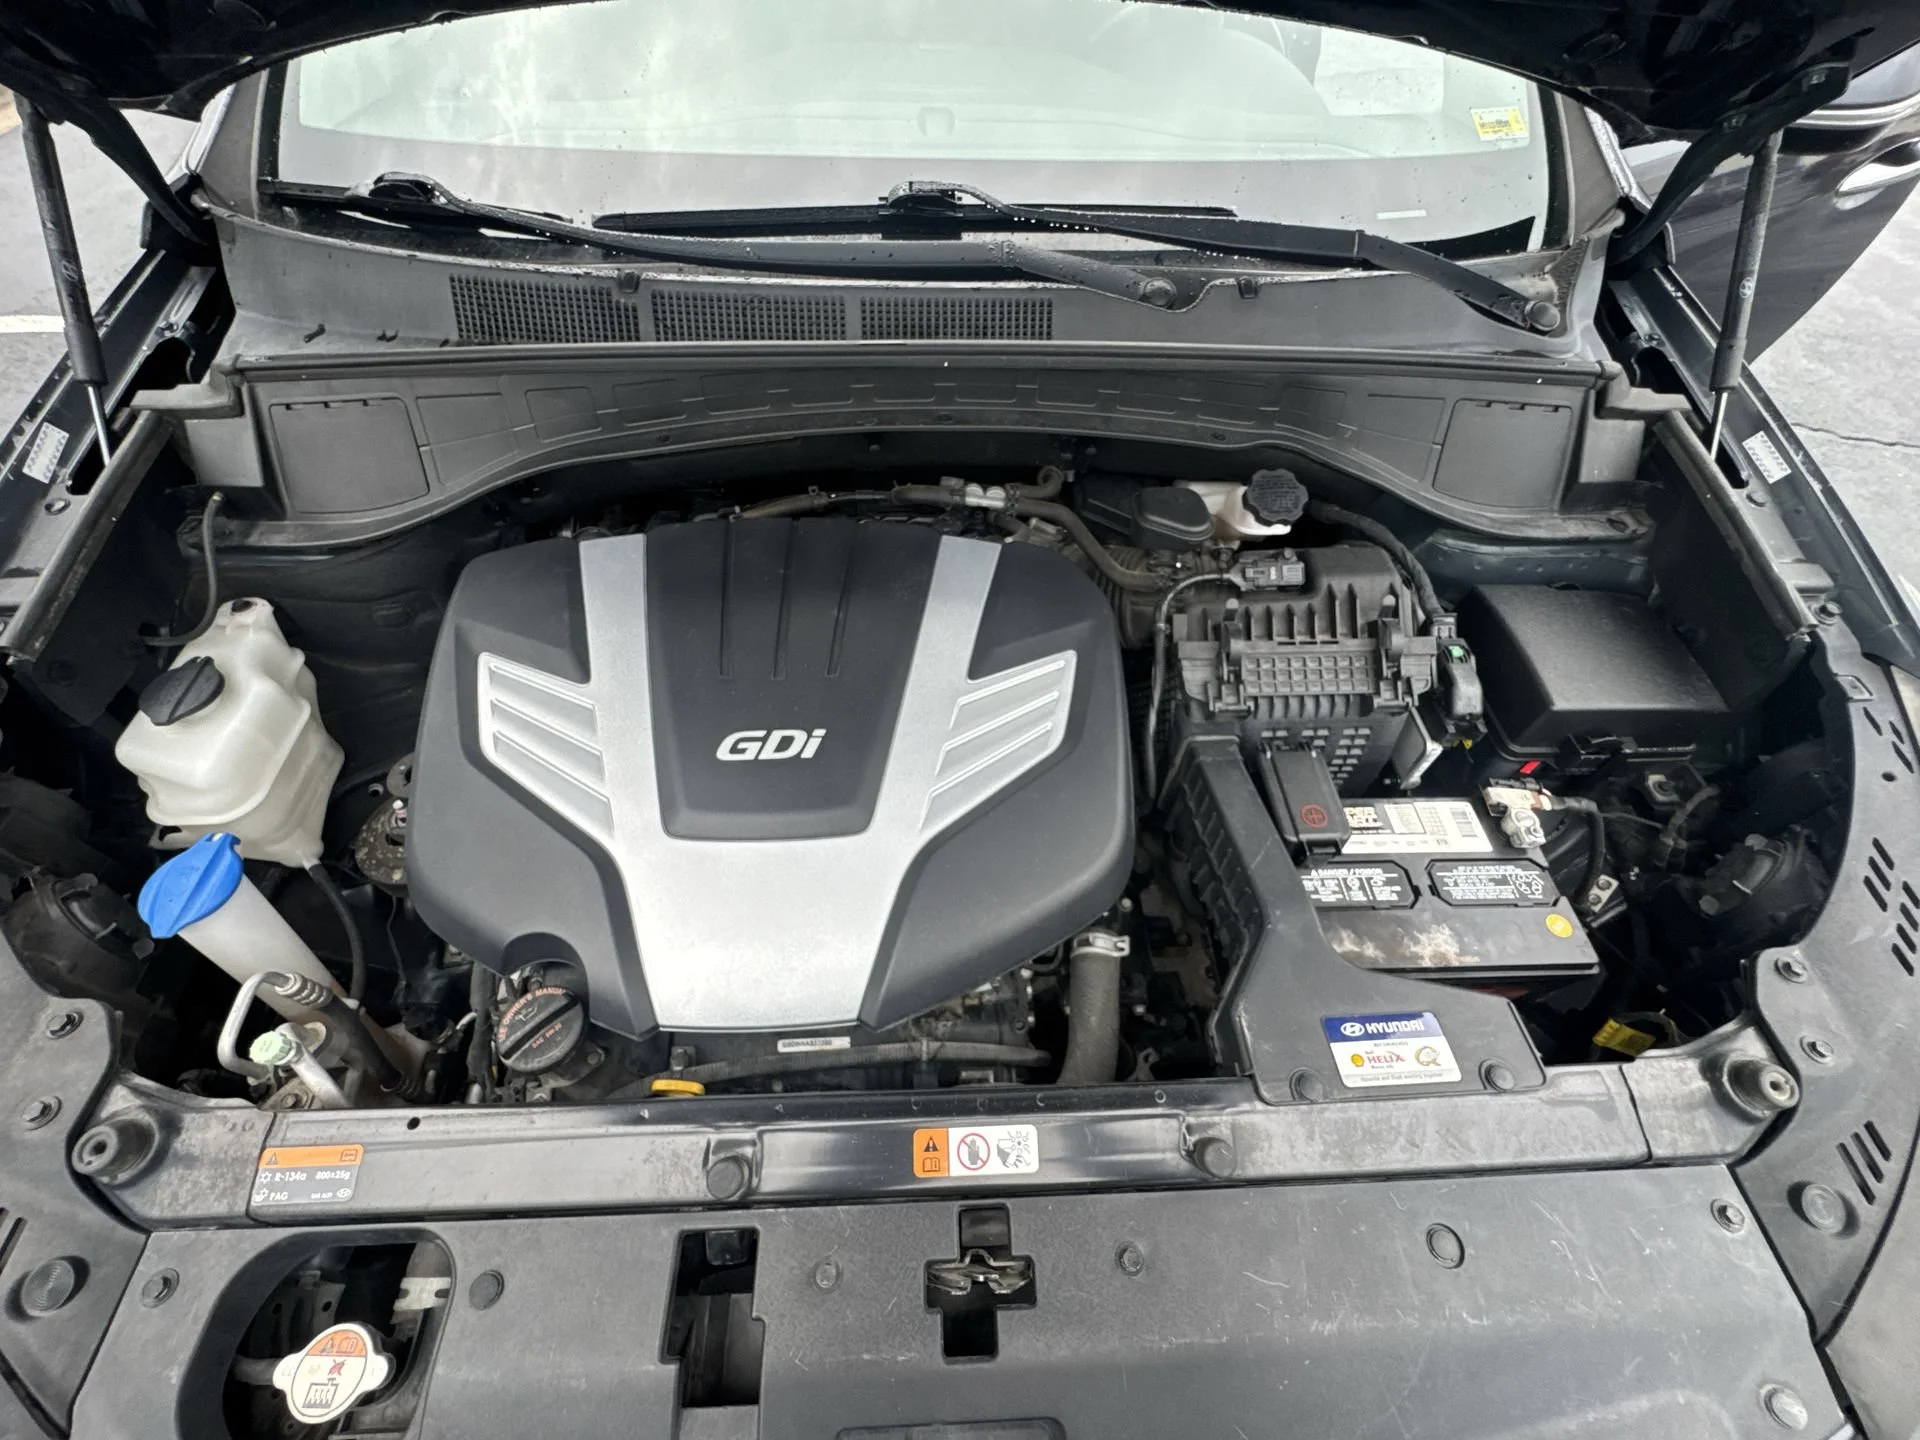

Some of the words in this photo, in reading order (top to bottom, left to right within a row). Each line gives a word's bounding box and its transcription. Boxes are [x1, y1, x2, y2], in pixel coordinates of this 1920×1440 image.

[716, 728, 827, 761] GDi
[1365, 1021, 1425, 1034] HYUNDAI
[1367, 1051, 1406, 1064] HELIX
[274, 1171, 307, 1182] R-134a
[269, 1192, 289, 1201] PAG
